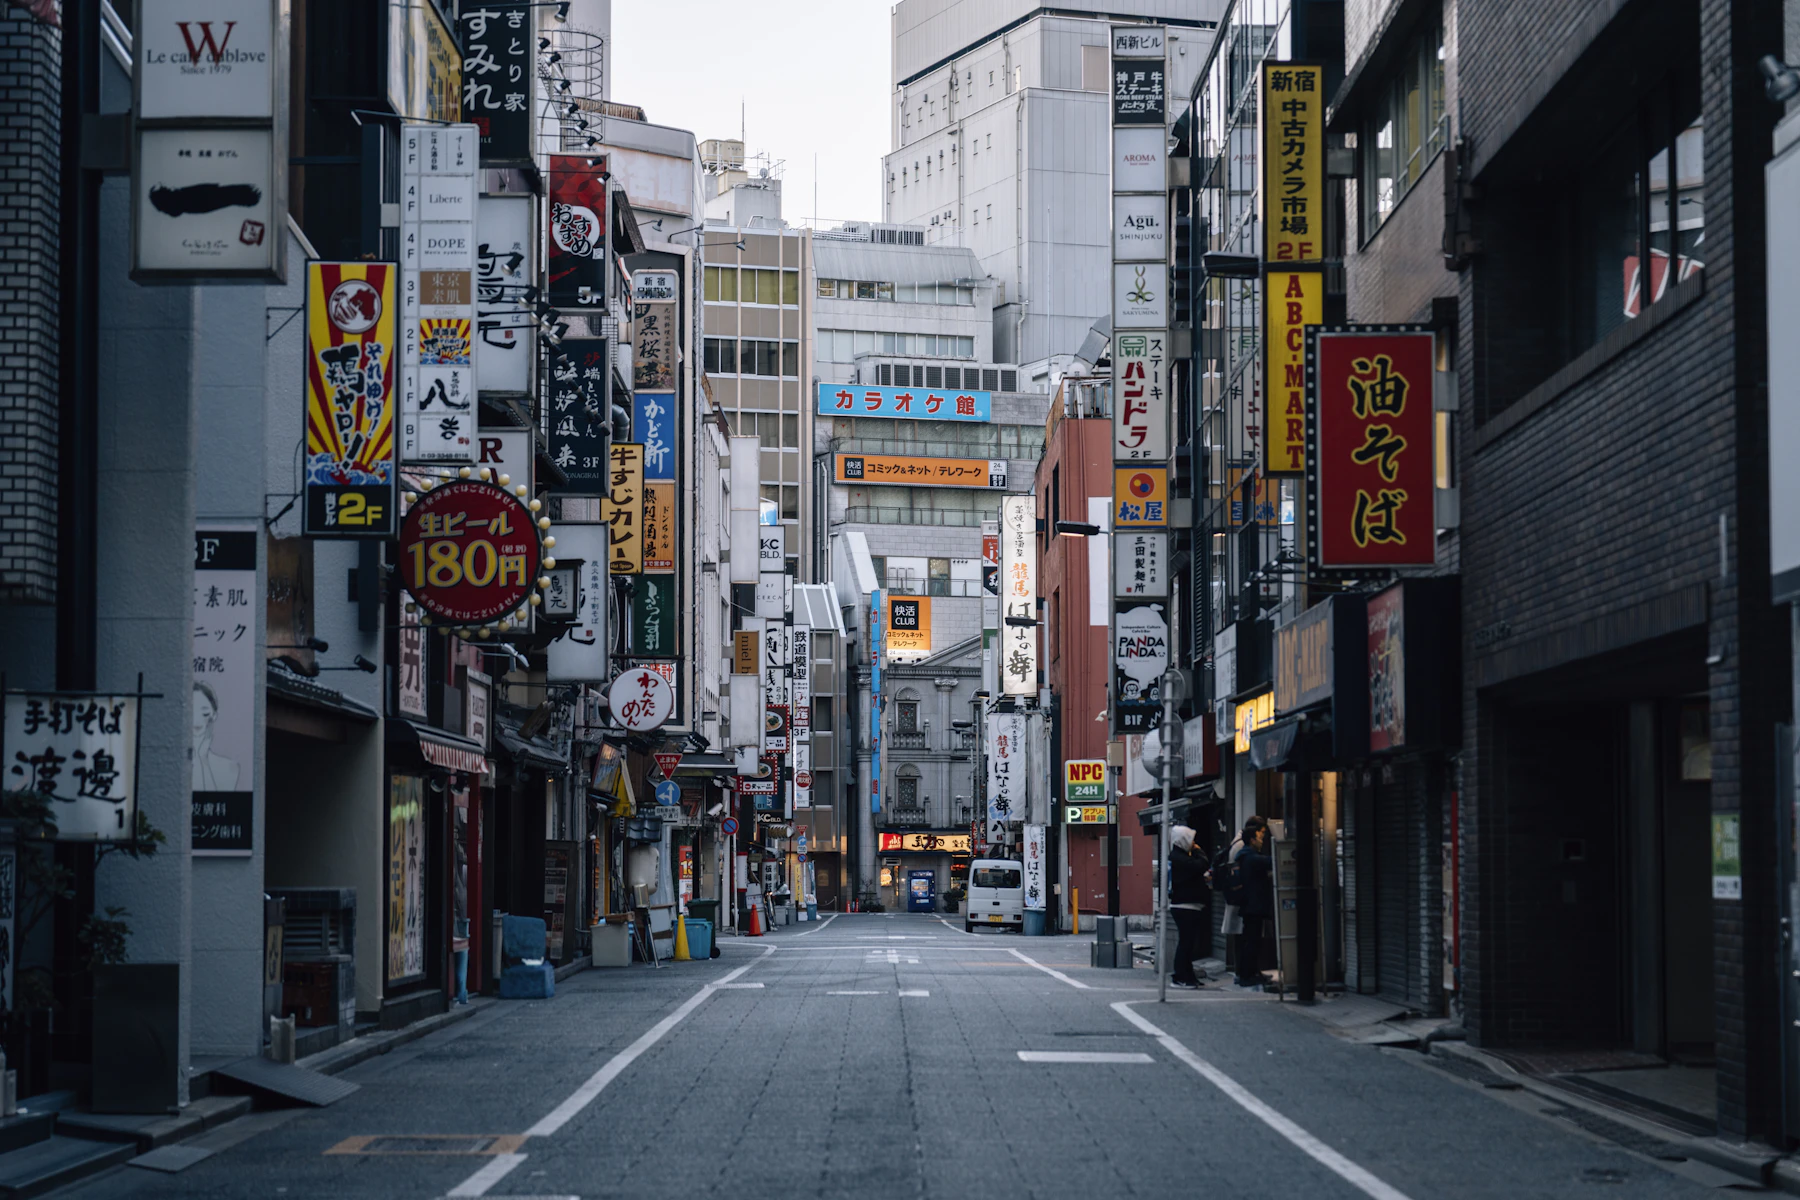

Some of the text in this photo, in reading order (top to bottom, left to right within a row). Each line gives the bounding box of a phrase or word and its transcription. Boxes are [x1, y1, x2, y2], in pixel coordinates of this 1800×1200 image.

[175, 21, 237, 67] W
[1116, 35, 1162, 50] 西新ビル
[147, 49, 166, 64] Le
[462, 8, 501, 111] すみれ
[181, 65, 232, 75] Since 1979
[1116, 71, 1163, 84] 神戸牛
[1271, 70, 1316, 92] 新宿
[1116, 84, 1163, 95] ステーキ
[1123, 154, 1156, 162] AROMA
[1280, 98, 1309, 235] 中古カメラ市場
[428, 238, 466, 249] DOPE
[1120, 233, 1163, 241] SHINJUKU
[1276, 242, 1313, 260] 2F
[432, 272, 460, 287] 東京
[577, 285, 603, 305] 5F
[1150, 338, 1163, 400] ステーキ
[835, 389, 976, 416] カラオケ館
[1118, 360, 1148, 449] パンドラ
[1130, 450, 1152, 458] 2F
[1347, 354, 1411, 548] 油そば
[582, 457, 600, 469] 3F
[846, 461, 862, 470] 快活
[939, 466, 982, 477] テレワーク
[337, 492, 383, 527] 2F
[609, 447, 637, 558] 牛すじカレー
[1118, 501, 1163, 522] 松屋
[418, 510, 515, 539] 生ビール
[760, 539, 779, 550] KC
[407, 539, 528, 590] 180円
[1134, 536, 1146, 594] 三田製麺所
[194, 585, 248, 607] 素肌
[895, 605, 915, 617] 快活
[895, 617, 915, 626] CLUB
[1119, 635, 1165, 648] PANDA
[1117, 647, 1158, 659] LINDA
[24, 701, 126, 734] 手打そば
[1124, 714, 1144, 726] B1F
[793, 728, 807, 736] 3F
[1069, 763, 1103, 781] NPC
[1075, 786, 1098, 796] 24H
[1067, 807, 1081, 823] P
